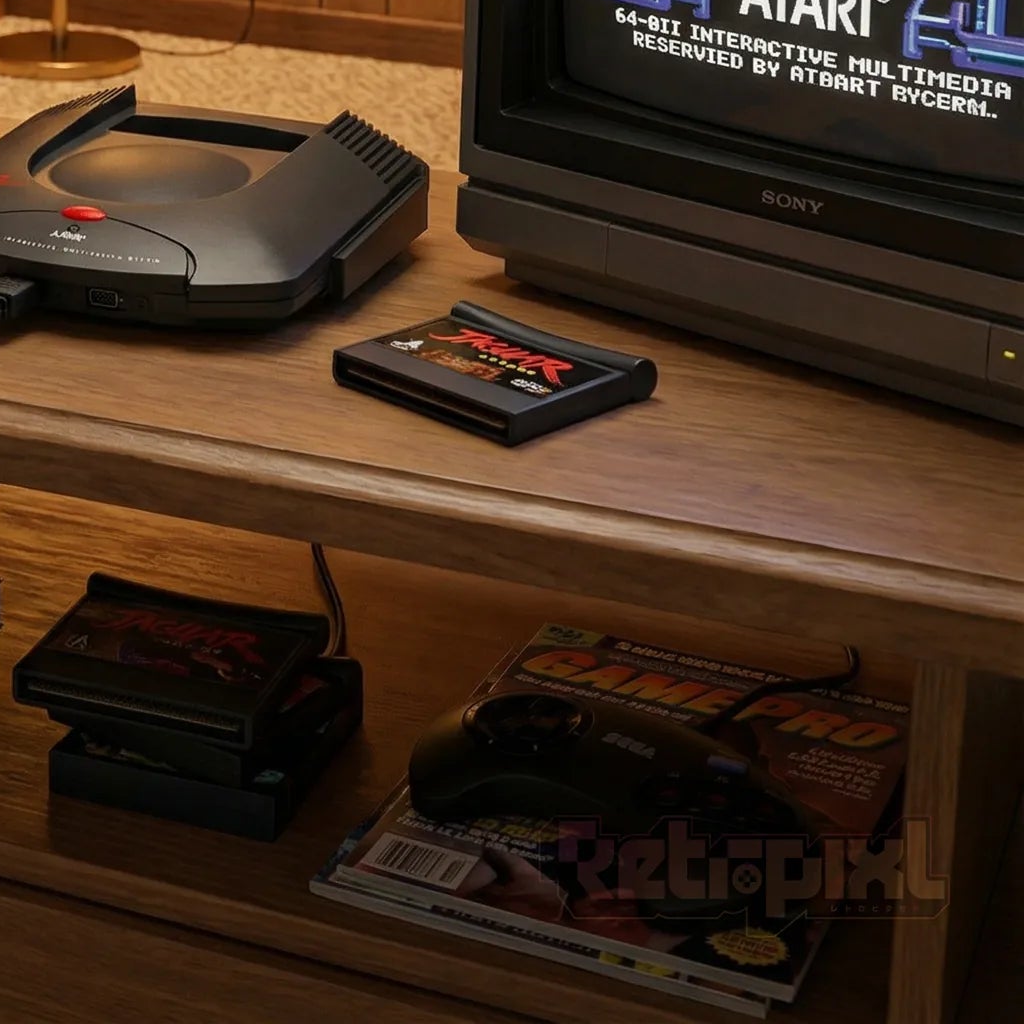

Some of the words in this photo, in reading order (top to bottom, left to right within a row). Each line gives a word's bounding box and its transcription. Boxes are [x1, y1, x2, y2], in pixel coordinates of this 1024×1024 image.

[633, 30, 744, 70] RESERVIED
[752, 57, 780, 77] BY
[690, 23, 837, 69] INTERACTIVE
[848, 55, 1012, 100] MULTIMEDIA
[761, 189, 825, 215] SONY
[520, 649, 902, 749] GAMEPRO
[600, 732, 656, 760] SEGA
